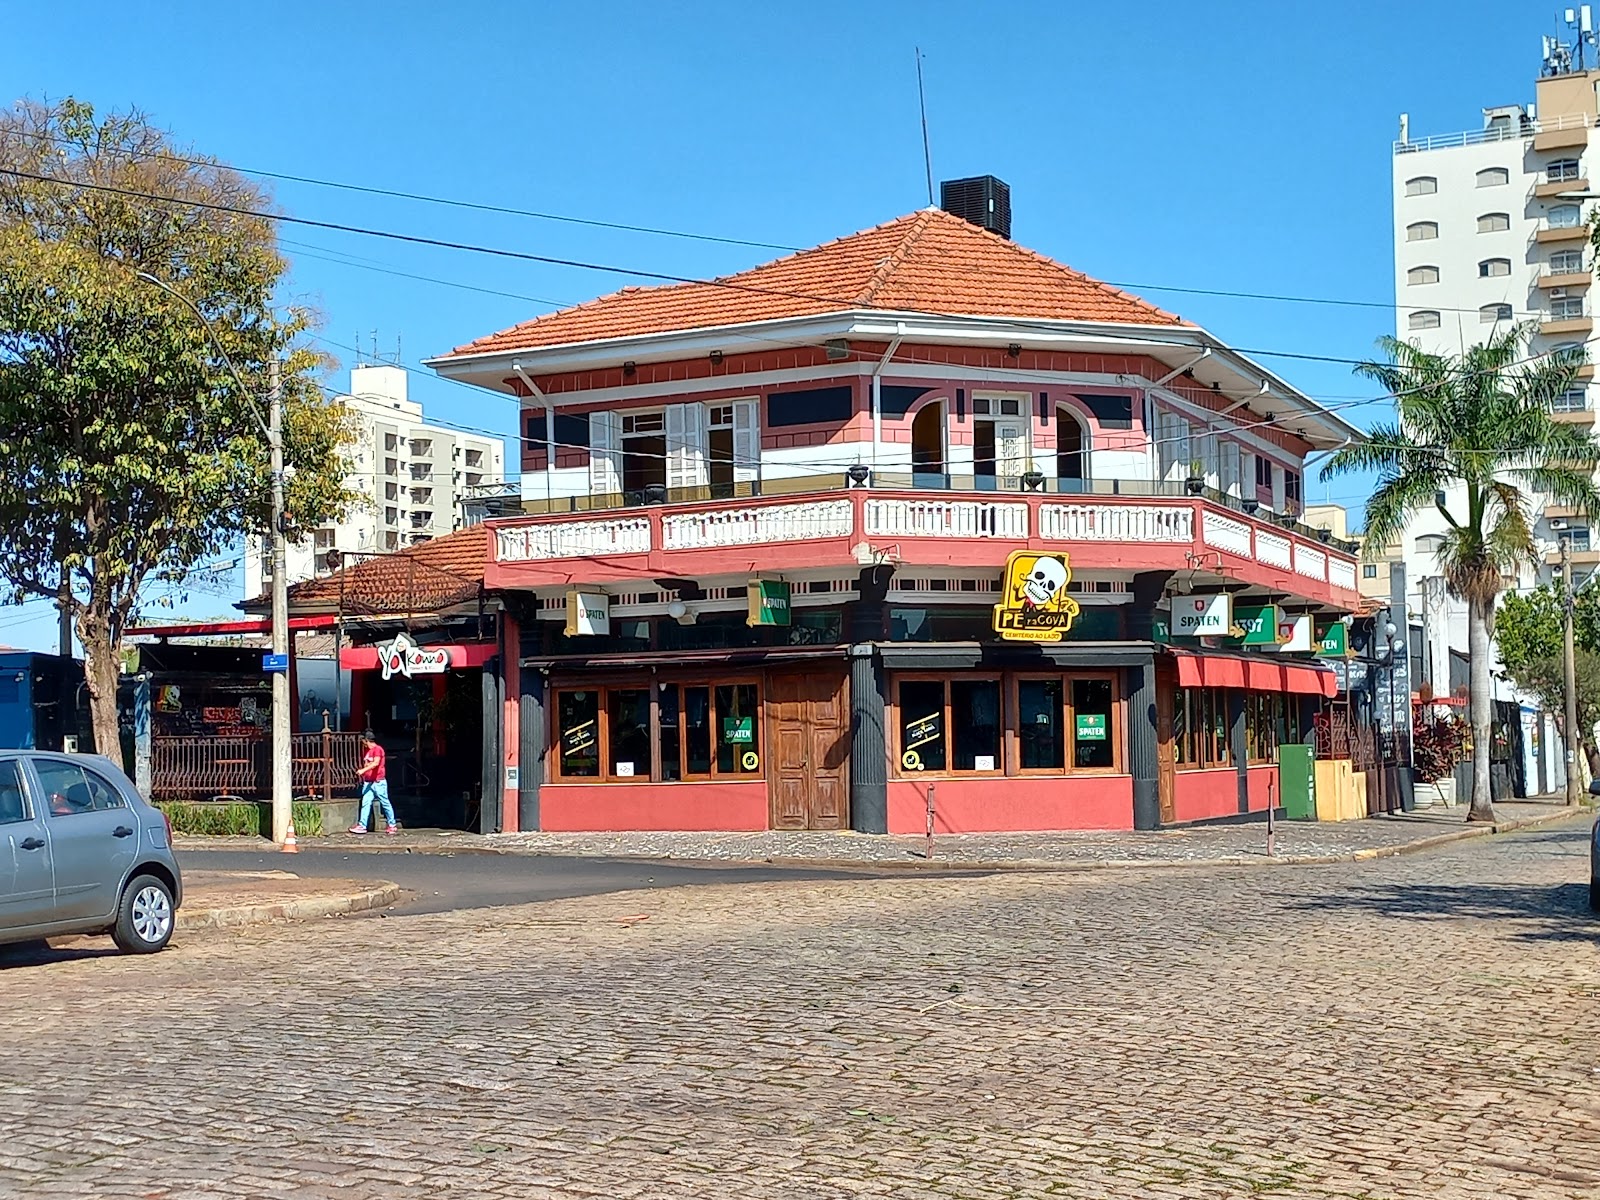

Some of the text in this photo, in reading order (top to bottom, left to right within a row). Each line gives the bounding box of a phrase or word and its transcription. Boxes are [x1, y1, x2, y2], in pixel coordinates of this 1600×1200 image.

[767, 597, 787, 609] SPATEN
[1180, 615, 1220, 627] SPATEN
[725, 729, 751, 739] SPATEN
[1078, 727, 1105, 736] SPATEN
